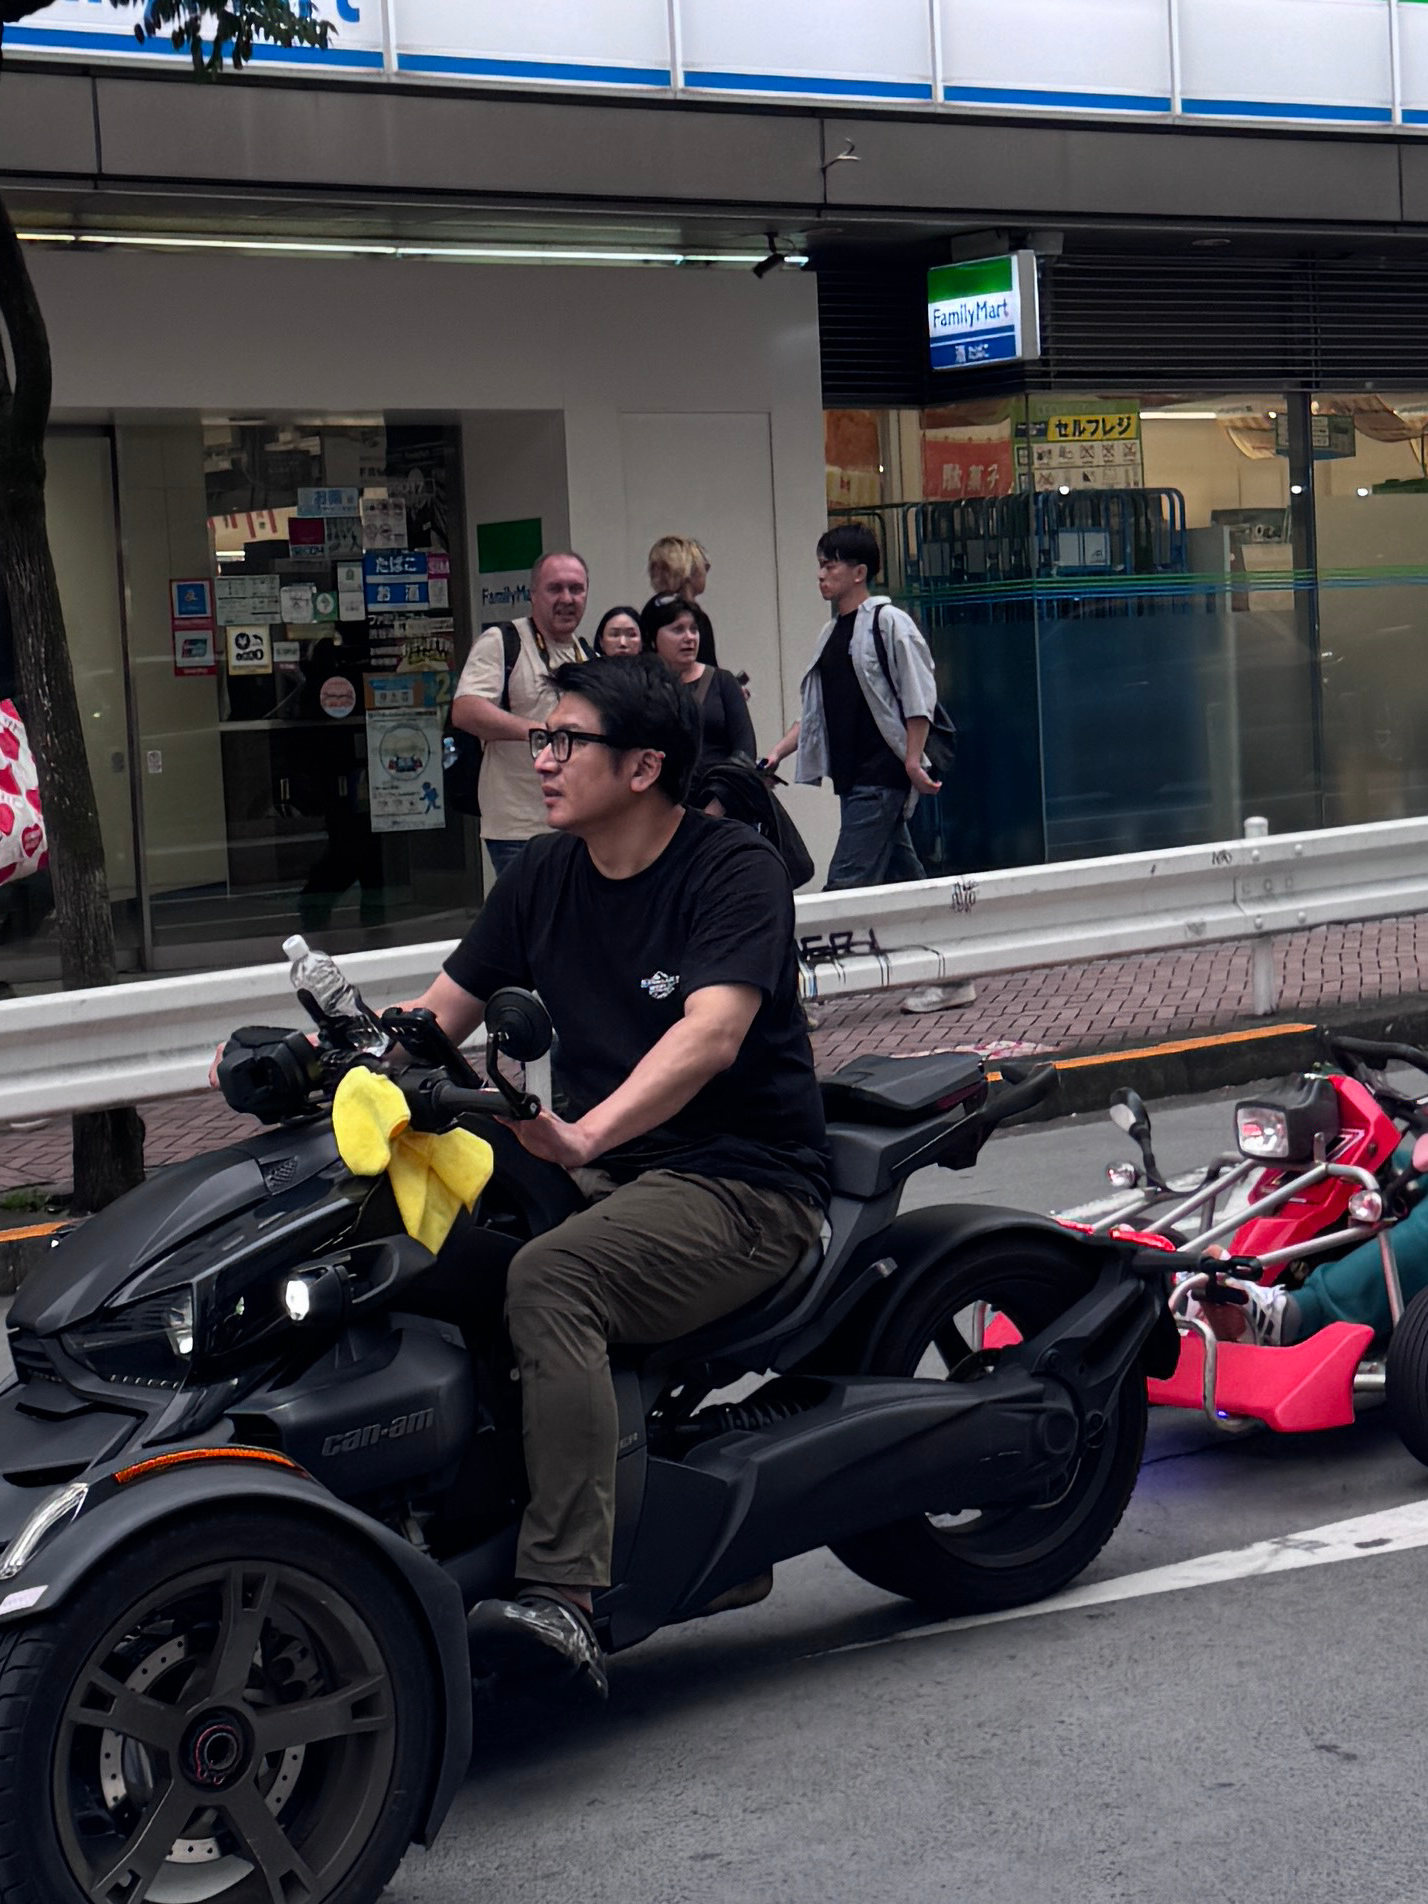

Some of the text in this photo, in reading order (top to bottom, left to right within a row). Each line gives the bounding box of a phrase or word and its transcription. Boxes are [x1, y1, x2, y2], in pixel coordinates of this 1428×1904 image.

[933, 298, 1009, 328] FamilyMart
[1055, 416, 1131, 438] セルフレジ
[375, 556, 417, 573] たばこ
[321, 1407, 434, 1457] can-am
